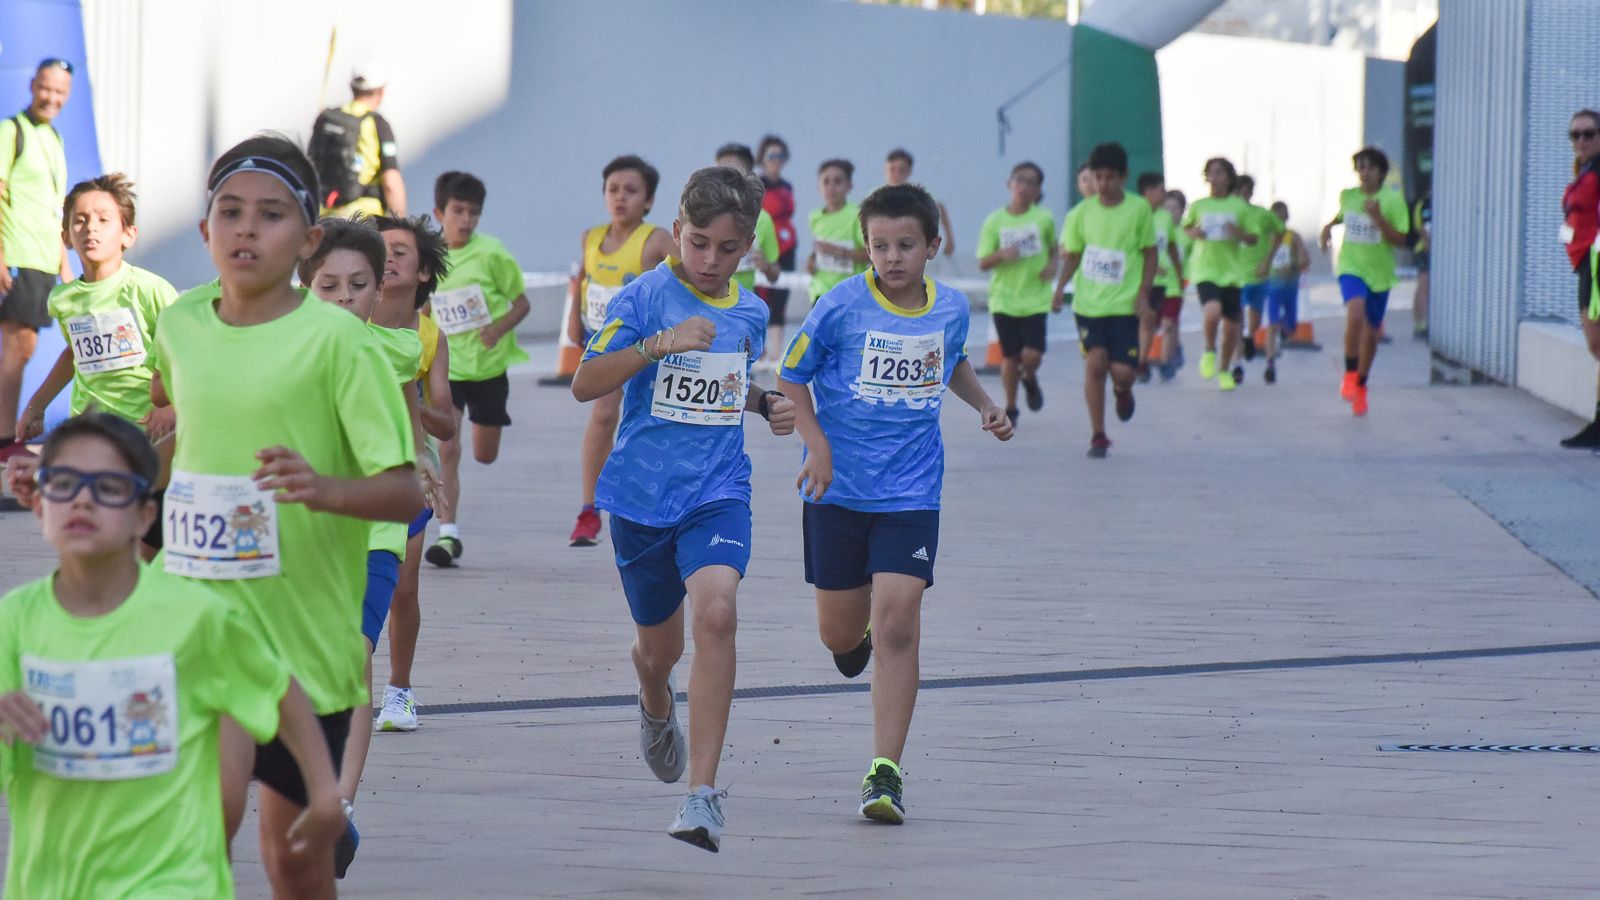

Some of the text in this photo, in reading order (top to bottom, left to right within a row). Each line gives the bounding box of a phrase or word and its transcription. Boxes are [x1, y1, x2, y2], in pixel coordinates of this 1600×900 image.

[437, 304, 467, 322] 1219
[76, 333, 112, 358] 1387
[869, 337, 886, 349] XXI
[664, 354, 702, 366] XXI Carrera
[682, 361, 701, 369] Popular
[869, 356, 922, 381] 1263
[663, 374, 720, 405] 1520
[169, 509, 228, 550] 1152
[911, 553, 929, 562] adidas
